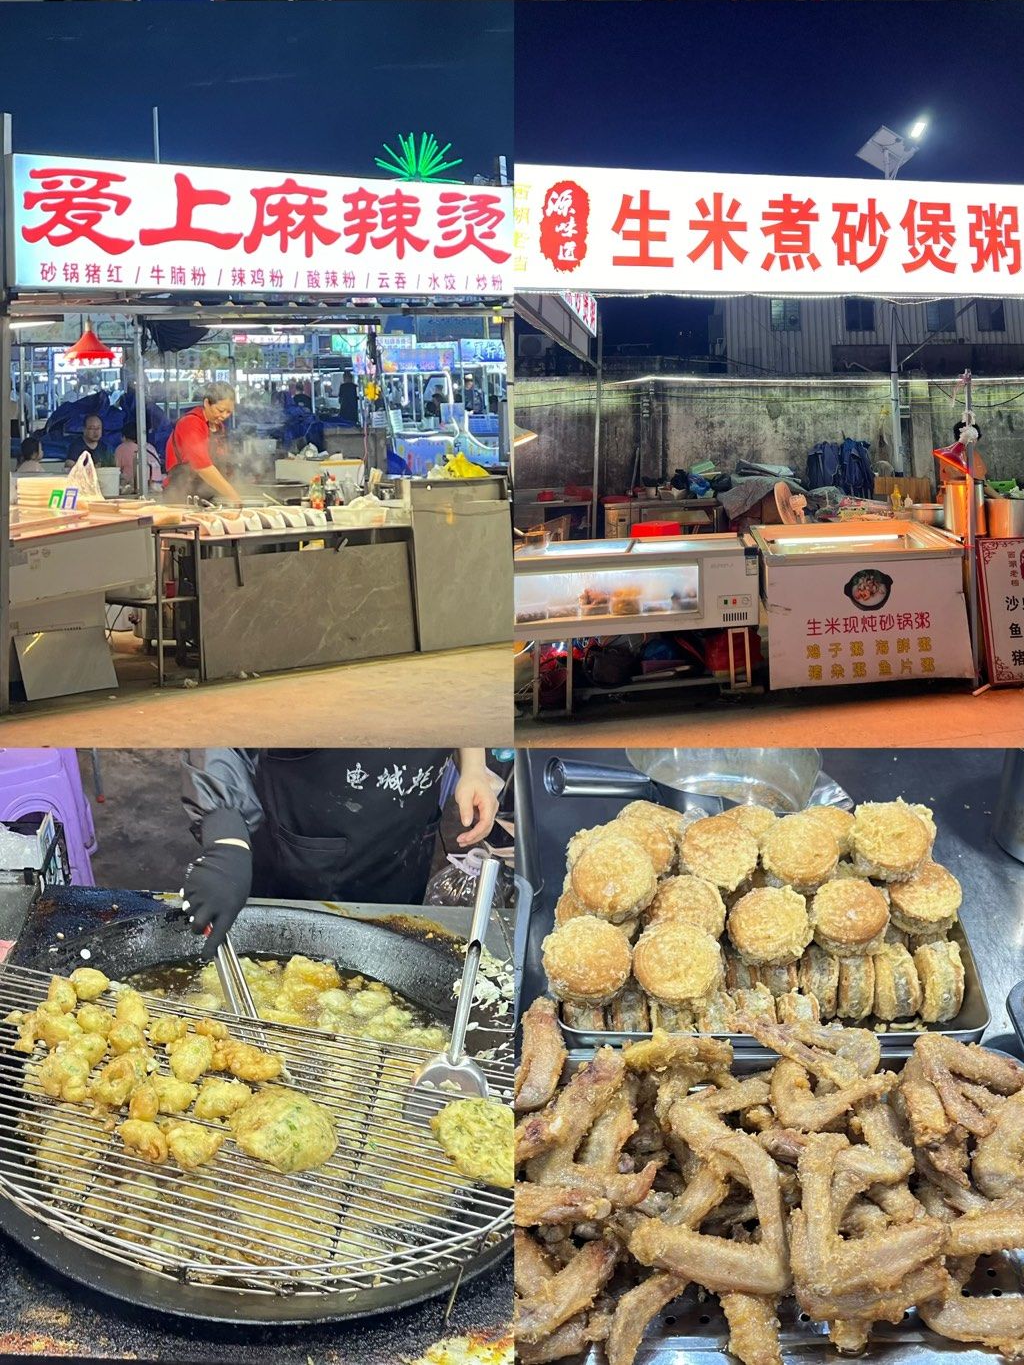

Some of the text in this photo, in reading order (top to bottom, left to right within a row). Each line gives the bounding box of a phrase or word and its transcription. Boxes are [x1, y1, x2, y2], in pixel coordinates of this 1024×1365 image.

[21, 168, 512, 264] 爱上麻辣烫
[610, 189, 1022, 276] 生米煮砂煲粥
[39, 262, 504, 292] 砂锅猪红 牛腩粉 辣鸡粉 酸辣粉 云吞 水饺 炒粉
[806, 611, 931, 637] 生米现炖砂锅粥
